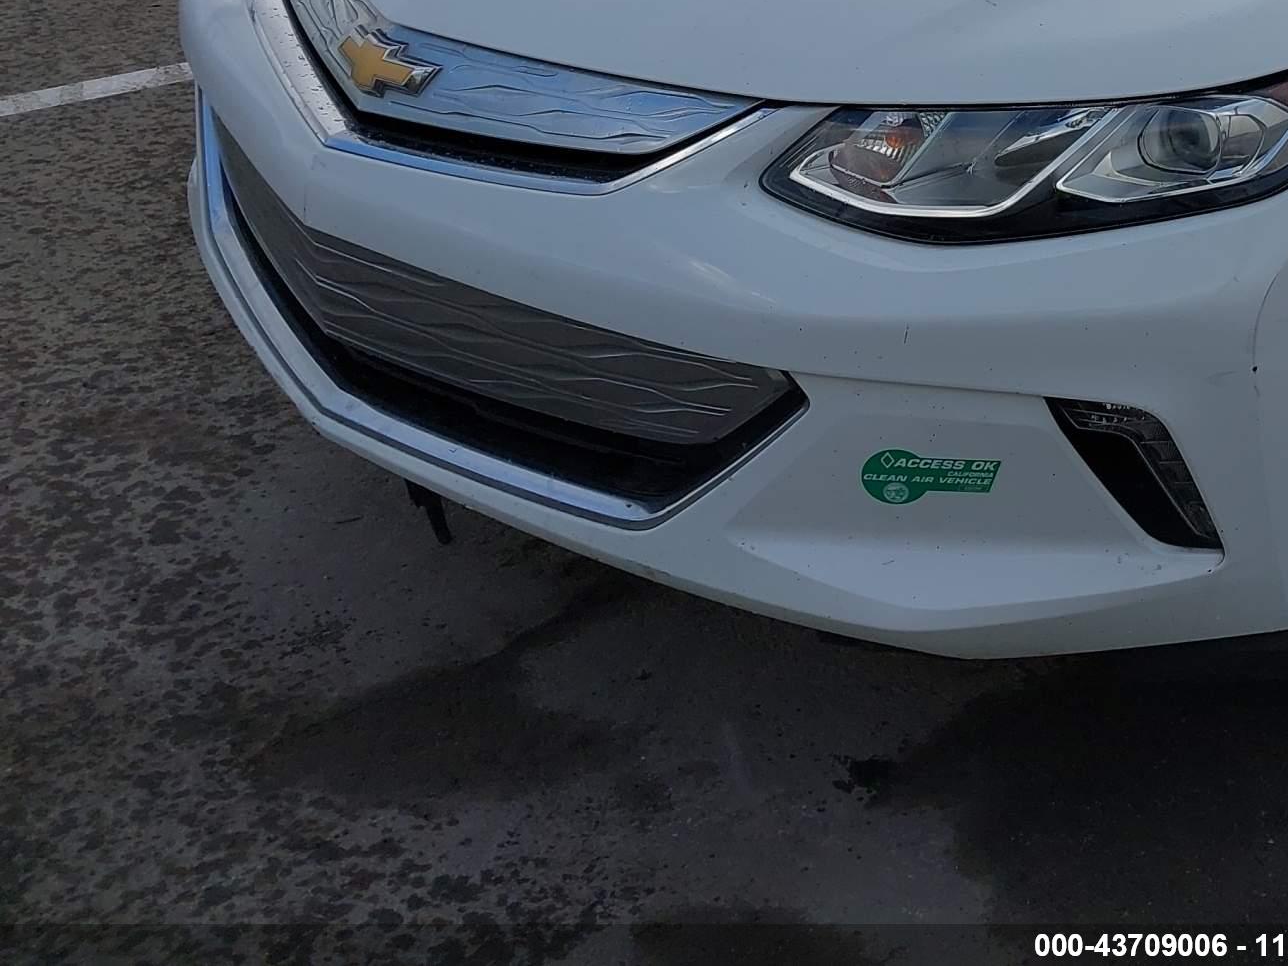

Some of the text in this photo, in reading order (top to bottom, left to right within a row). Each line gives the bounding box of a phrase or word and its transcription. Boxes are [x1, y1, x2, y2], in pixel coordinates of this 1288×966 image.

[894, 458, 998, 471] ACCESS OK
[863, 474, 908, 482] CLEAN
[939, 477, 993, 485] VEHICLE
